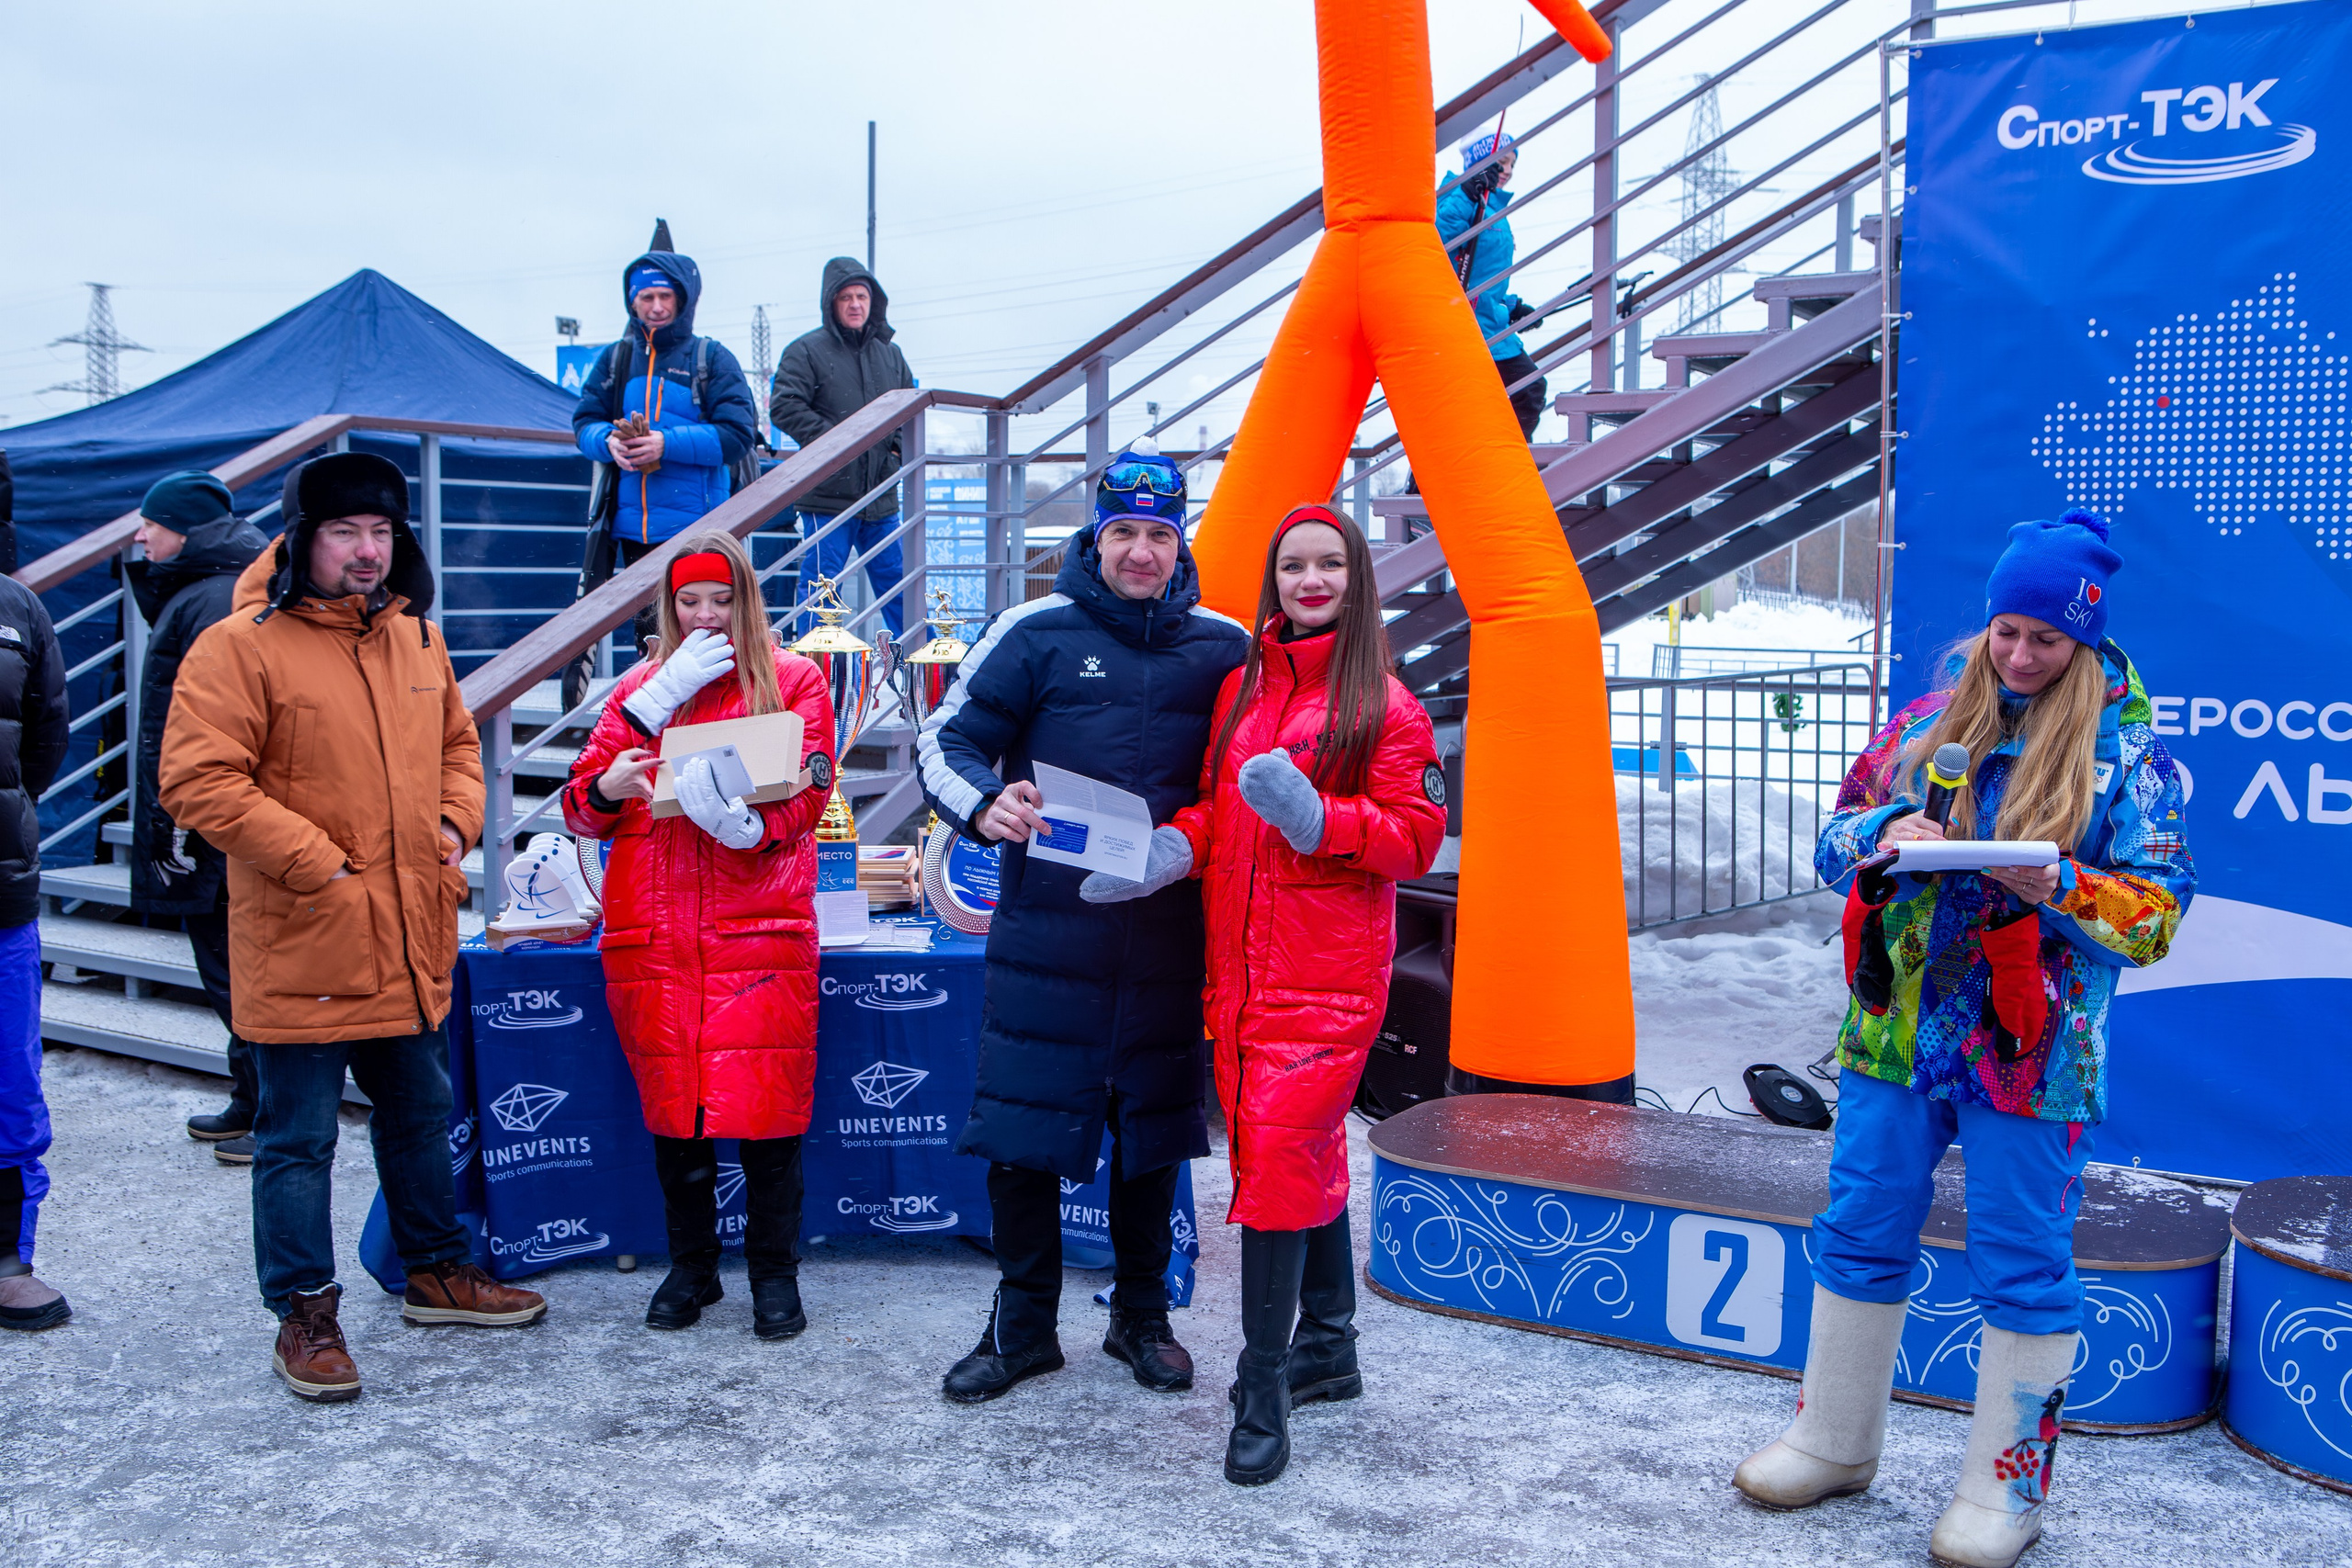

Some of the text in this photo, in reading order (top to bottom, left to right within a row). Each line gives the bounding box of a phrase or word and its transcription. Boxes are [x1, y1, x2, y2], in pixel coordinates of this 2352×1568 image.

[2075, 577, 2087, 601] I
[2064, 602, 2094, 629] SKI
[1289, 739, 1310, 757] H&H
[1405, 1043, 1418, 1055] RCF
[1299, 1055, 1313, 1066] LOVE
[839, 1115, 947, 1134] UNEVENTS
[482, 1136, 591, 1167] UNEVENTS
[842, 1136, 948, 1149] Sports communications
[486, 1157, 594, 1183] Sports communications
[1701, 1230, 1748, 1342] 2
